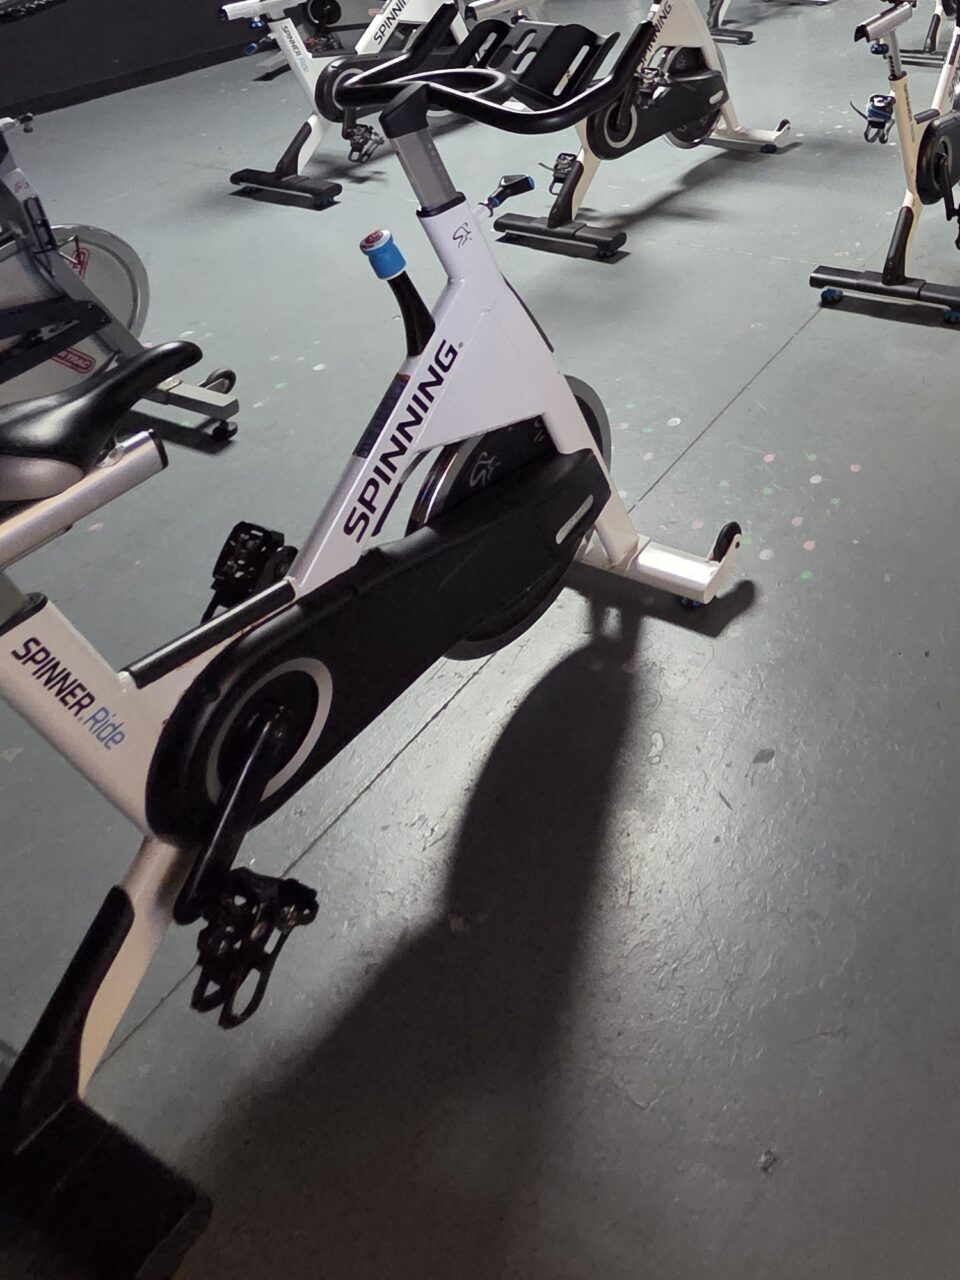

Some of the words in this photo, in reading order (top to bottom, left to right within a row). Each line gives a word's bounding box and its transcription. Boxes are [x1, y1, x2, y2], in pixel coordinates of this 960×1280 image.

[343, 339, 458, 543] SPINNING
[11, 637, 95, 718] SPINNER
[83, 706, 125, 750] Ride
